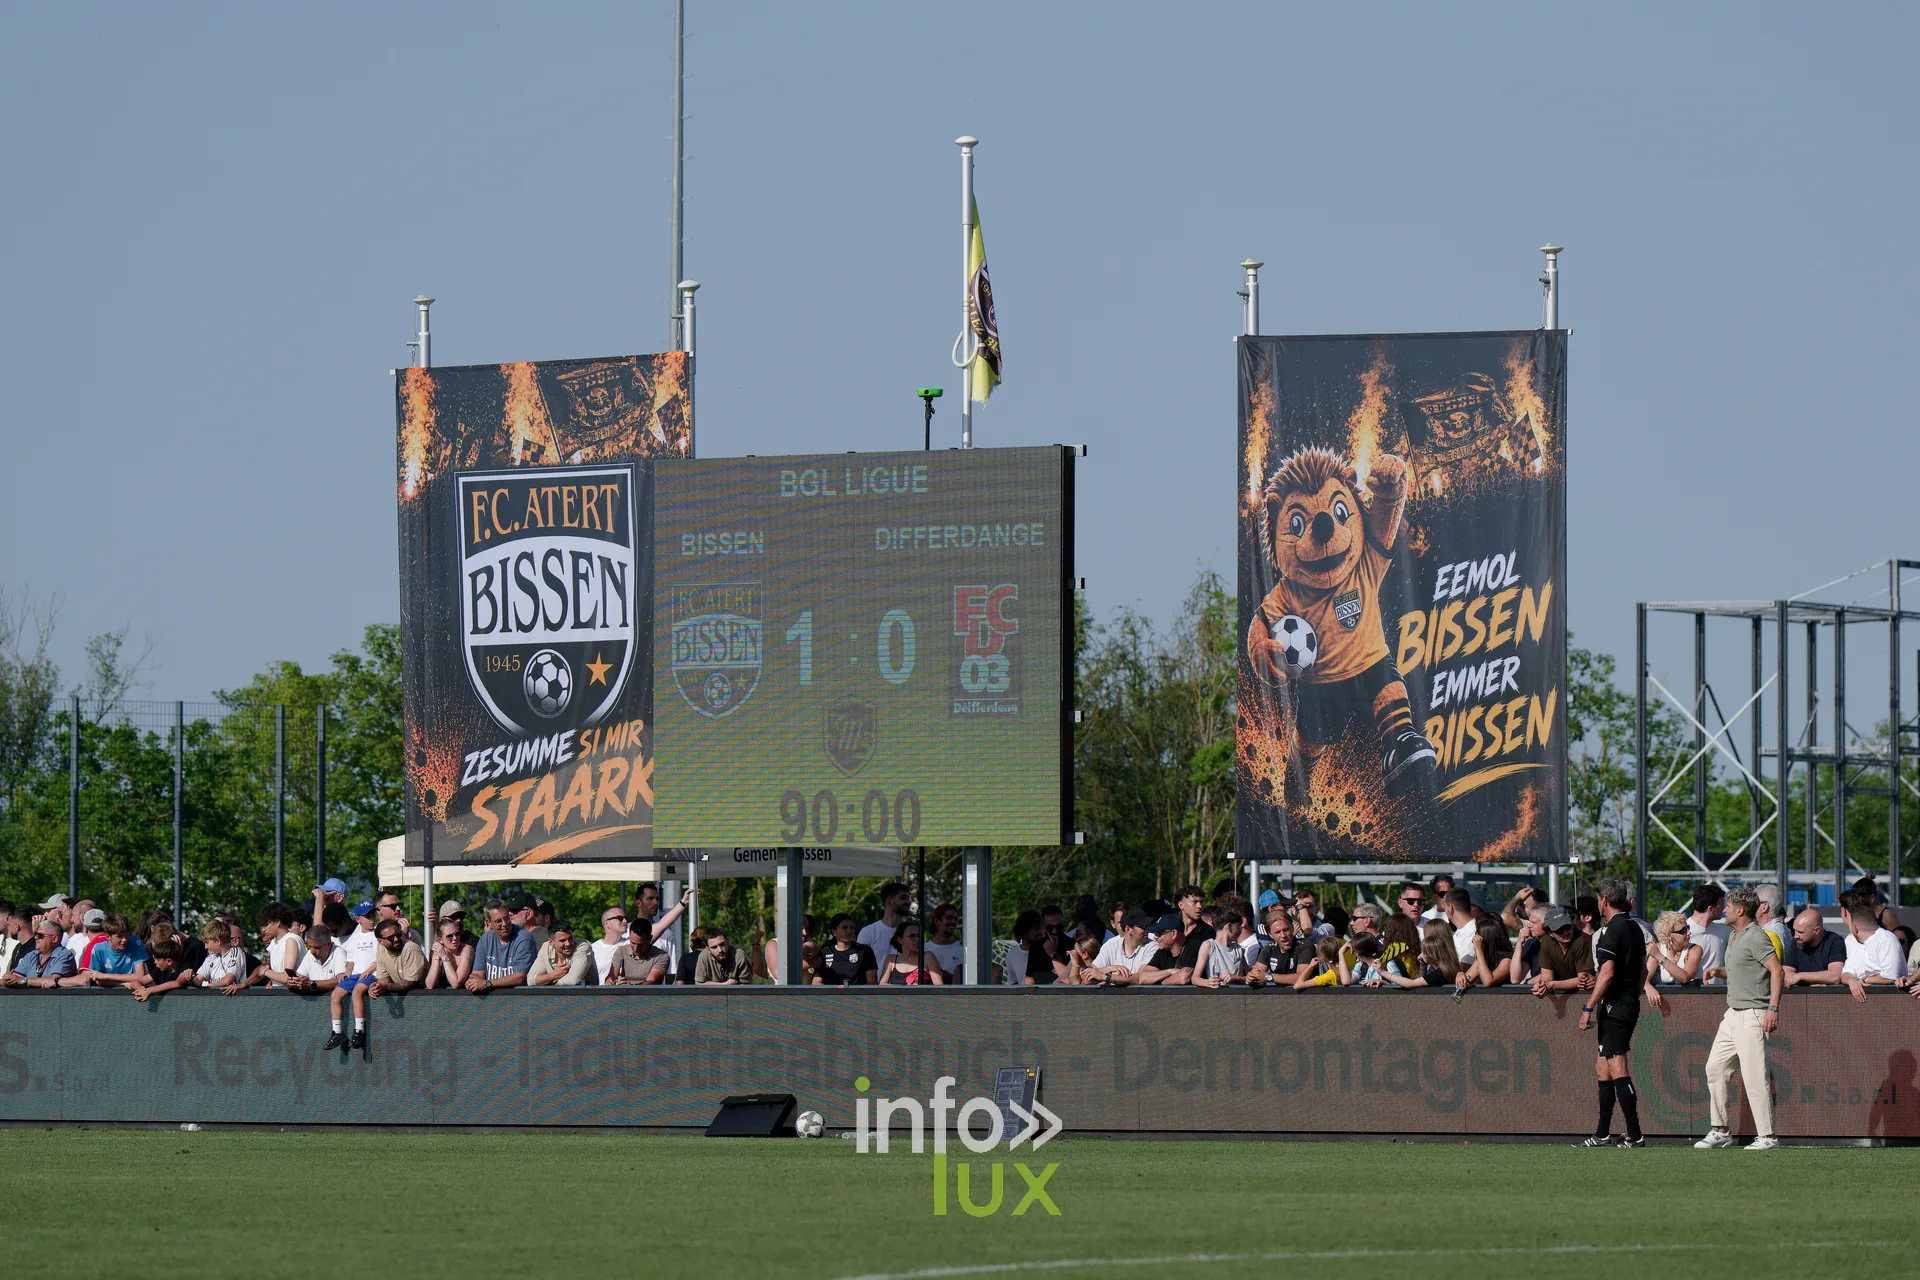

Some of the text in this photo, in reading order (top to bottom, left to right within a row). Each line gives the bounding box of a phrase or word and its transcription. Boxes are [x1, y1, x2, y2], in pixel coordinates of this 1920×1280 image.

[780, 465, 930, 498] BGL LIGUE
[681, 523, 1045, 556] BISSEN DIFFERDANGE
[468, 548, 629, 635] BISSEN
[1432, 548, 1522, 602] EEMOL
[1336, 600, 1361, 618] BISSEN
[1396, 576, 1553, 677] BIISSEN
[485, 654, 521, 672] 1945
[676, 621, 759, 663] BISSEN
[786, 611, 813, 685] 1
[877, 609, 917, 684] 0
[960, 654, 1010, 693] 03
[1430, 655, 1521, 710] EMMER
[460, 719, 644, 787] ZESUMME SI MIR
[1423, 683, 1559, 775] BIISSEN
[461, 752, 653, 853] STAARK
[779, 788, 921, 844] 90:00
[733, 847, 777, 862] Gemen
[1112, 1020, 1553, 1113] Demontagen
